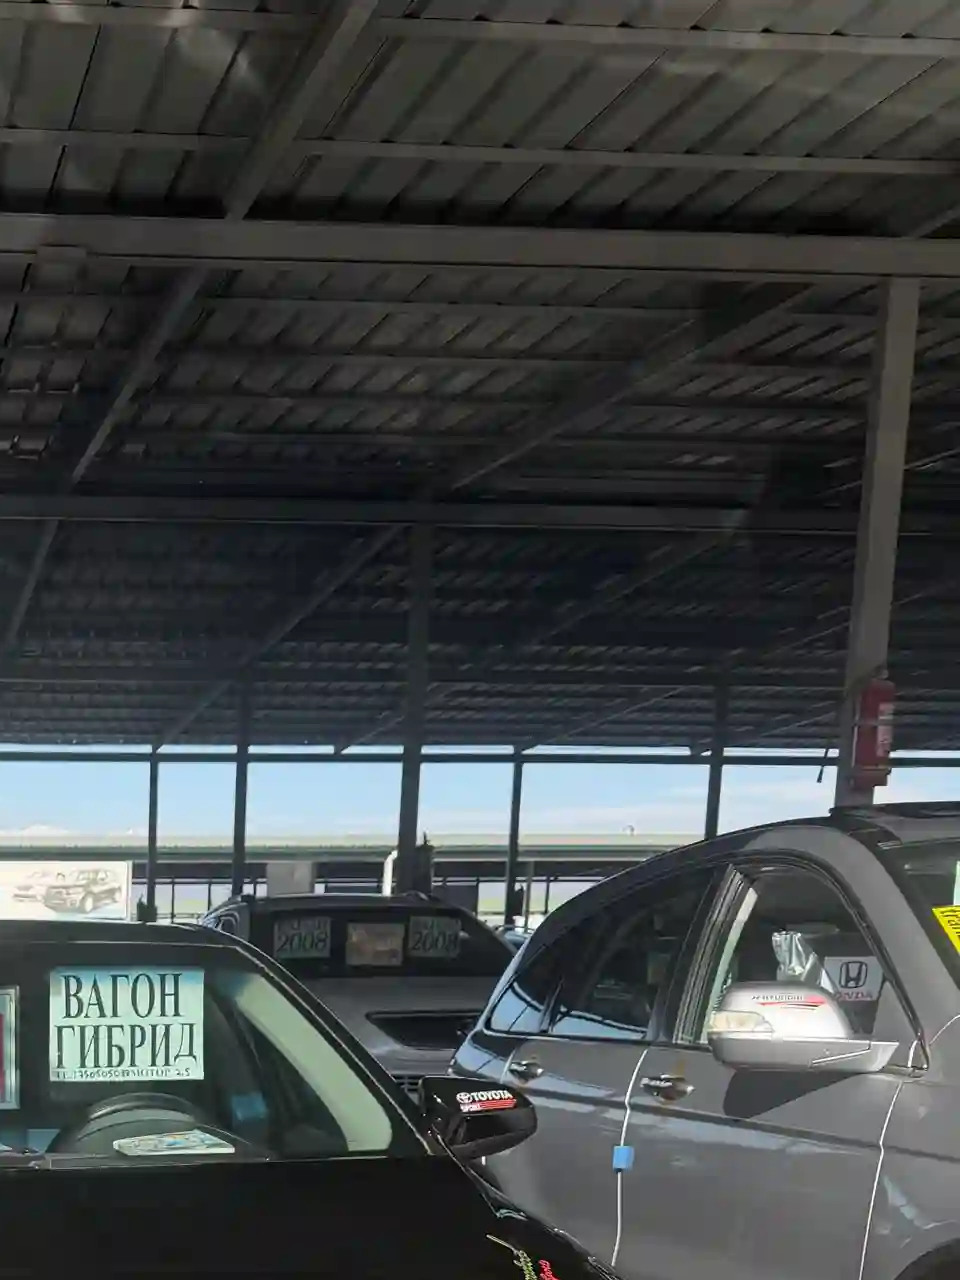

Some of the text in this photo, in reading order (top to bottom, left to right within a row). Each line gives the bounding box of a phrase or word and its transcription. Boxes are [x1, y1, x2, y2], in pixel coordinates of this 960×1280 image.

[61, 973, 183, 1018] ВАГОН
[54, 1023, 197, 1068] ГИБРИД
[471, 1090, 513, 1101] TOYOTA
